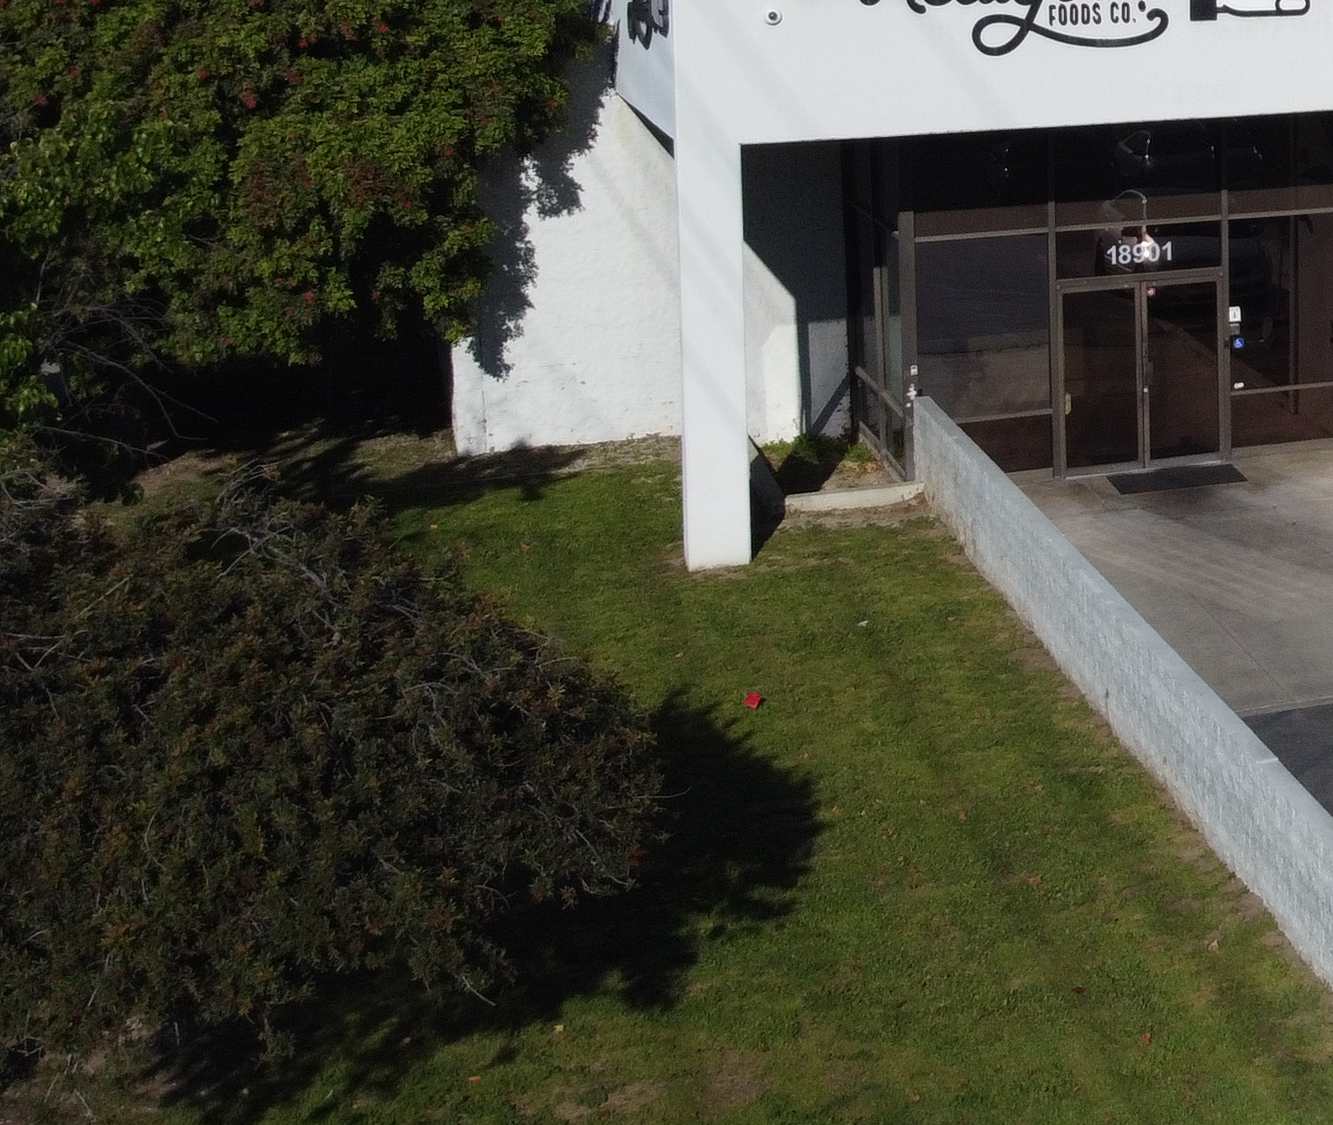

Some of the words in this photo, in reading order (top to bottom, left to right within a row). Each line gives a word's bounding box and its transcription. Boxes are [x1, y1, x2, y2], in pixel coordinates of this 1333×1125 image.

[1048, 3, 1102, 26] FOODS
[1110, 2, 1137, 24] CO.
[1106, 241, 1173, 265] 18901
